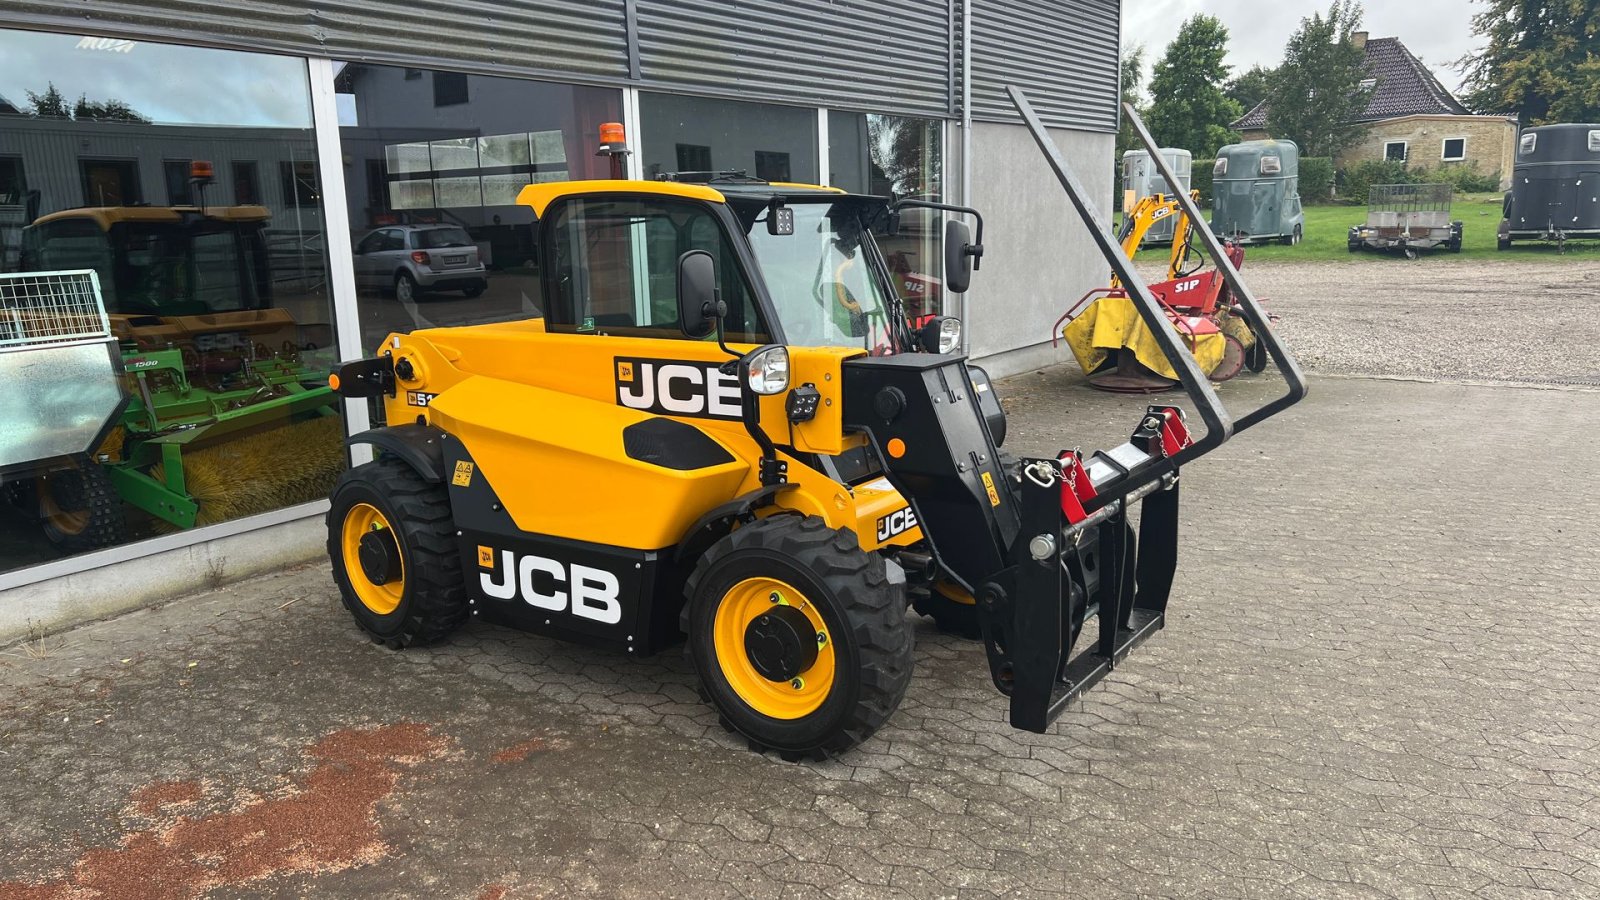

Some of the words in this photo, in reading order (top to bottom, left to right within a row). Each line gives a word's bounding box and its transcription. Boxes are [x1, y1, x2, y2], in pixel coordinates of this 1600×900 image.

[1151, 206, 1169, 219] JCB
[1175, 279, 1200, 293] SIP
[480, 549, 622, 625] JCB
